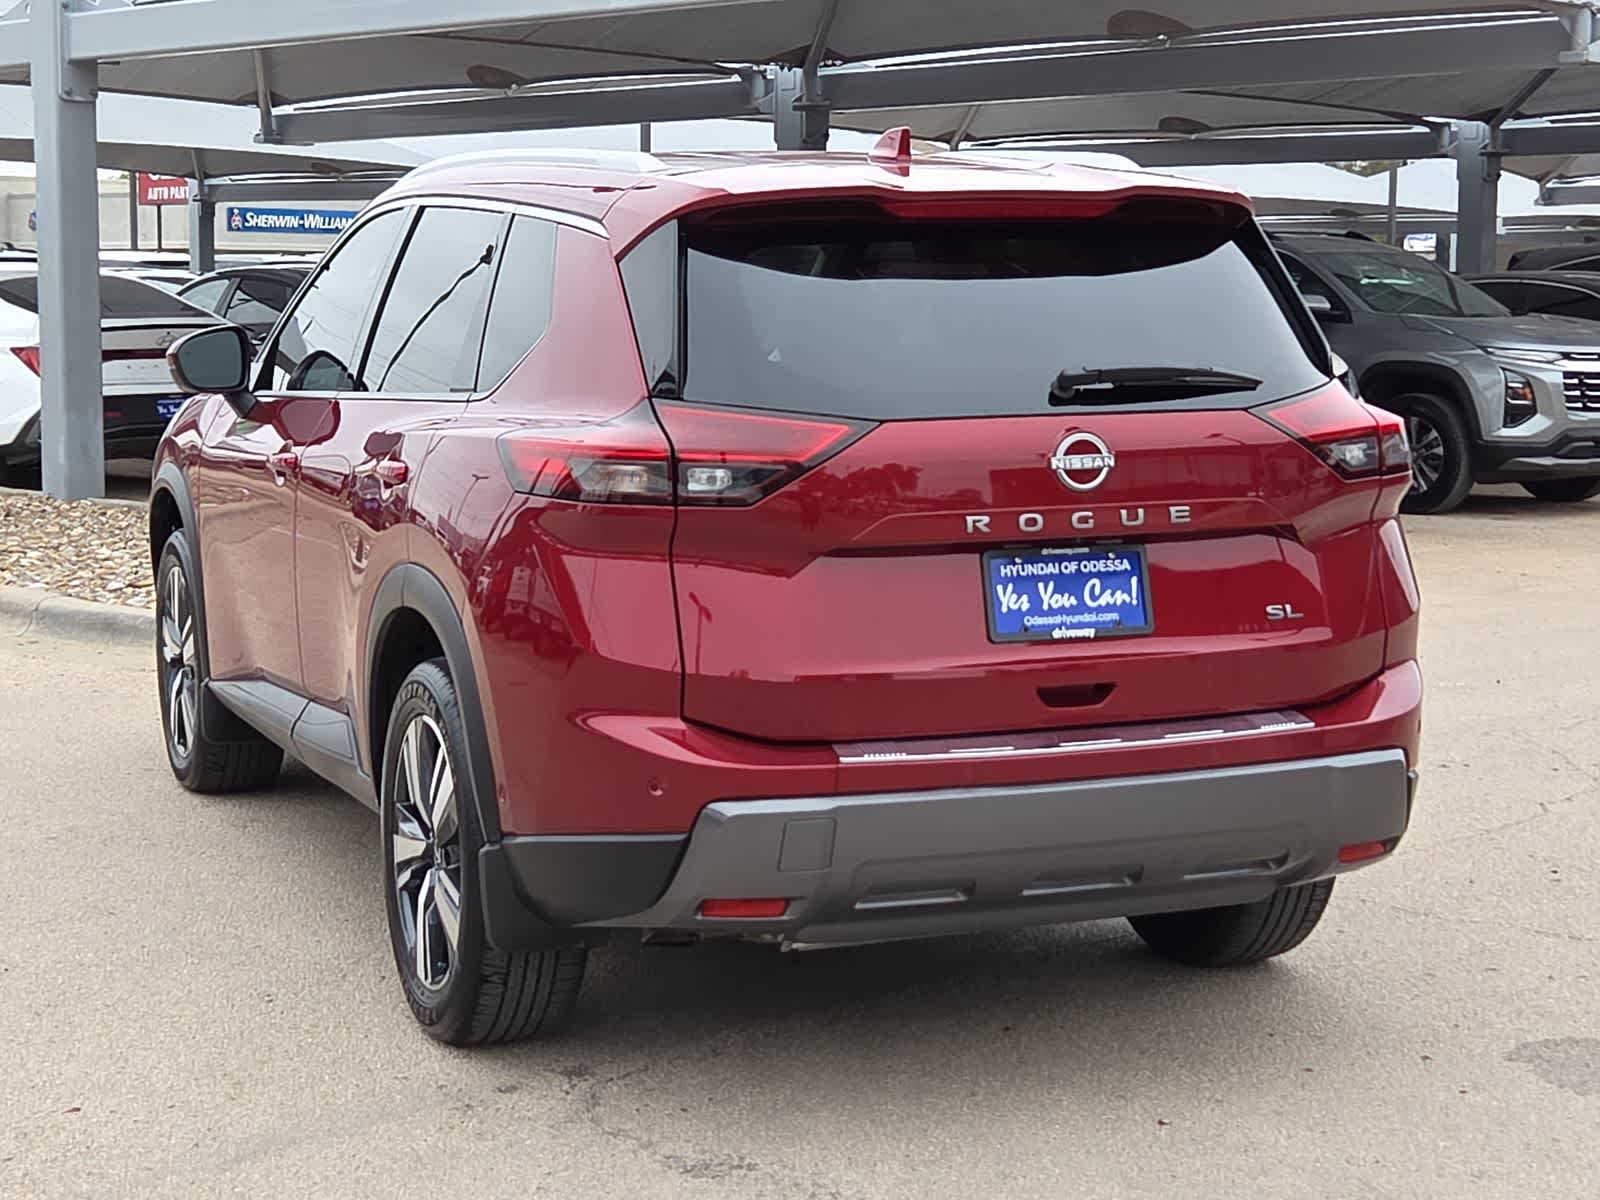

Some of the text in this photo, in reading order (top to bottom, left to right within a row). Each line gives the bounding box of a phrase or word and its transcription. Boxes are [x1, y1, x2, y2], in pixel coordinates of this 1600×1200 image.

[147, 185, 190, 200] AUTO PART
[244, 211, 354, 229] SHERWIN-WILLIAM
[1051, 454, 1116, 469] NISSAN
[965, 505, 1192, 534] ROGUE
[1000, 558, 1131, 577] HYUNDAI OF ODESSA
[996, 576, 1138, 613] Yes You Can!
[1023, 611, 1120, 627] OdessaHyundai.com
[1265, 604, 1304, 621] SL
